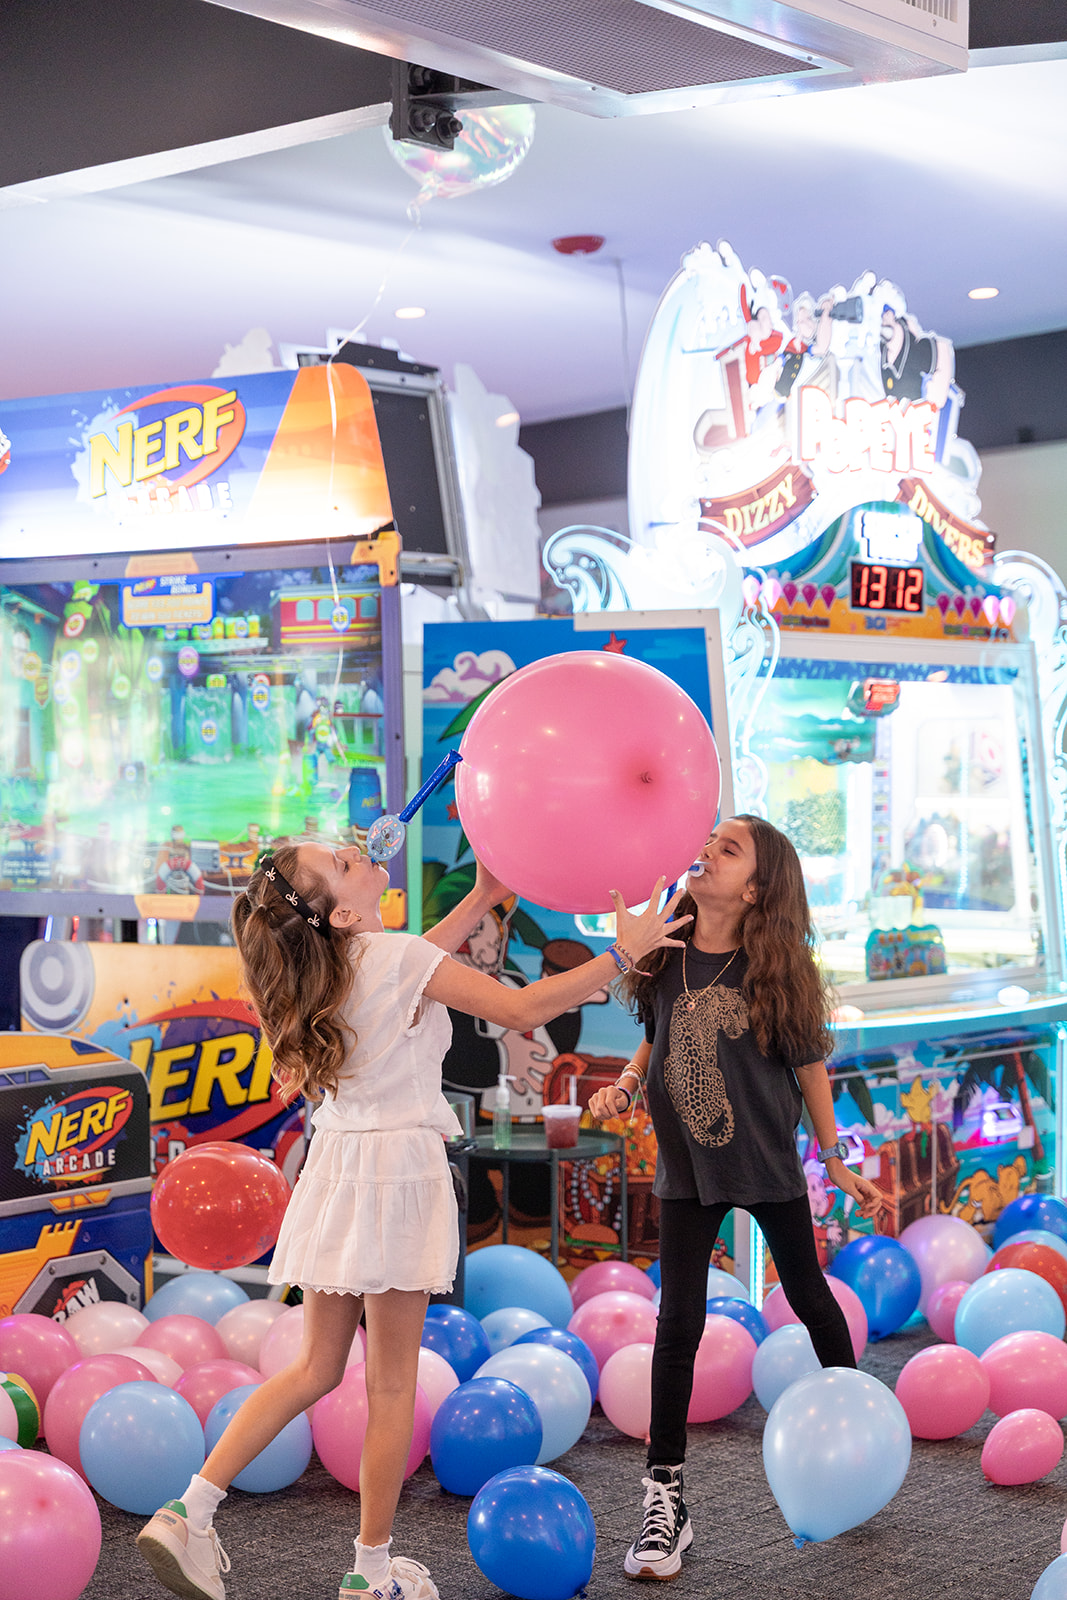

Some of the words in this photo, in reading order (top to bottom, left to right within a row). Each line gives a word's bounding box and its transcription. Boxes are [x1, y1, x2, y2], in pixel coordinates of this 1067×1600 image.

[89, 389, 237, 498] NERF
[800, 385, 936, 474] POPEYE
[723, 473, 797, 537] DIZZY
[908, 484, 985, 567] DIVERS
[24, 1090, 130, 1166] NERF
[43, 1148, 116, 1176] ARCADE
